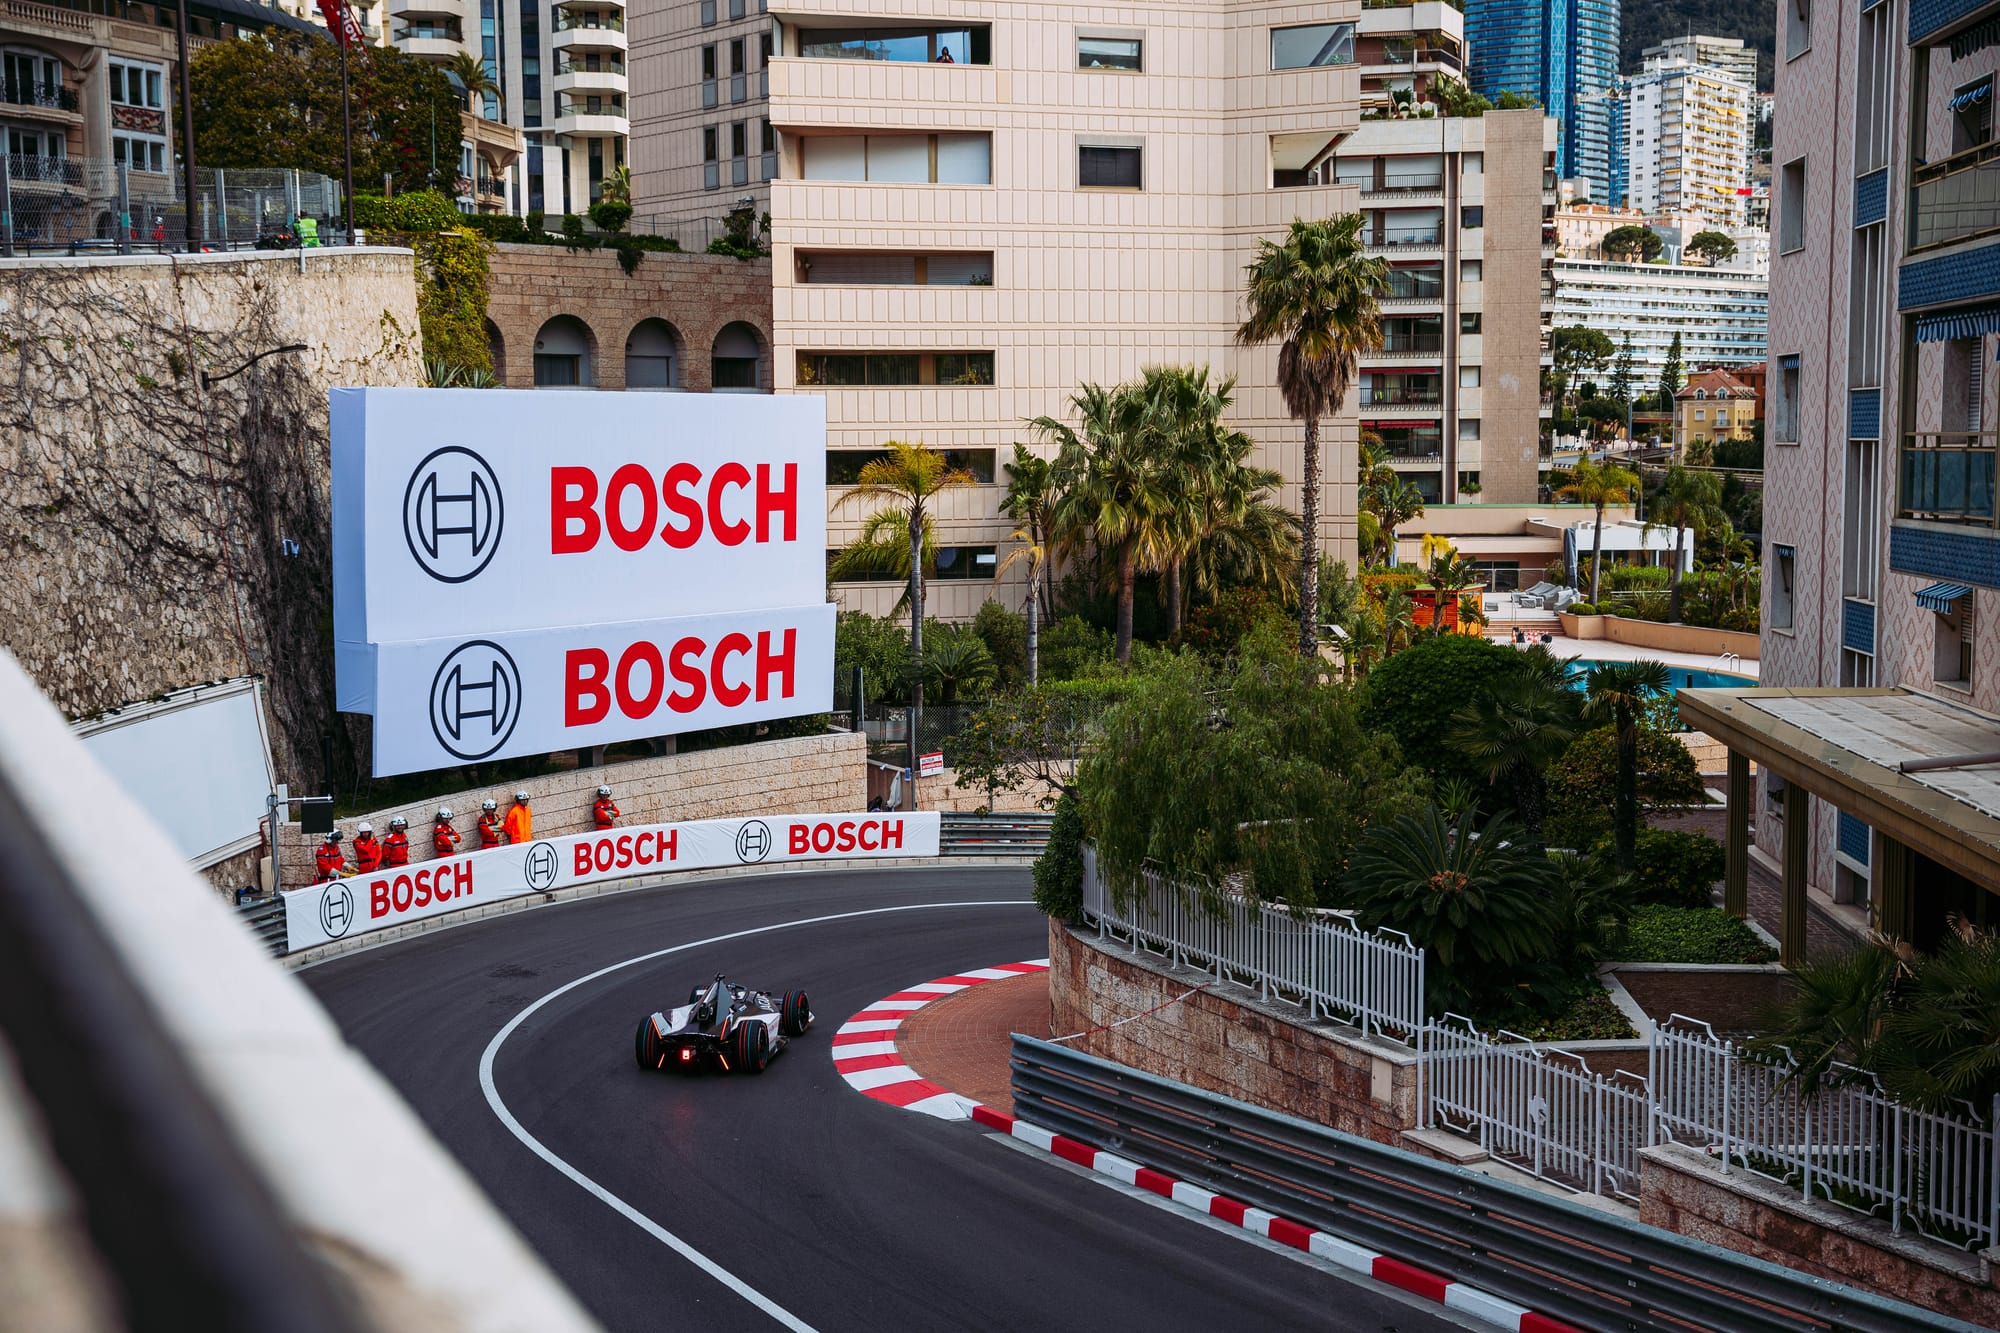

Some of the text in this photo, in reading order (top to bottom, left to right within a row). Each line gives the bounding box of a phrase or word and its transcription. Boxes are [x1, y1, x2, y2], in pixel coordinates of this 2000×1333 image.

[551, 462, 797, 554] BOSCH
[565, 628, 797, 727] BOSCH
[574, 829, 678, 876] BOSCH
[788, 820, 904, 855] BOSCH
[370, 860, 473, 919] BOSCH
